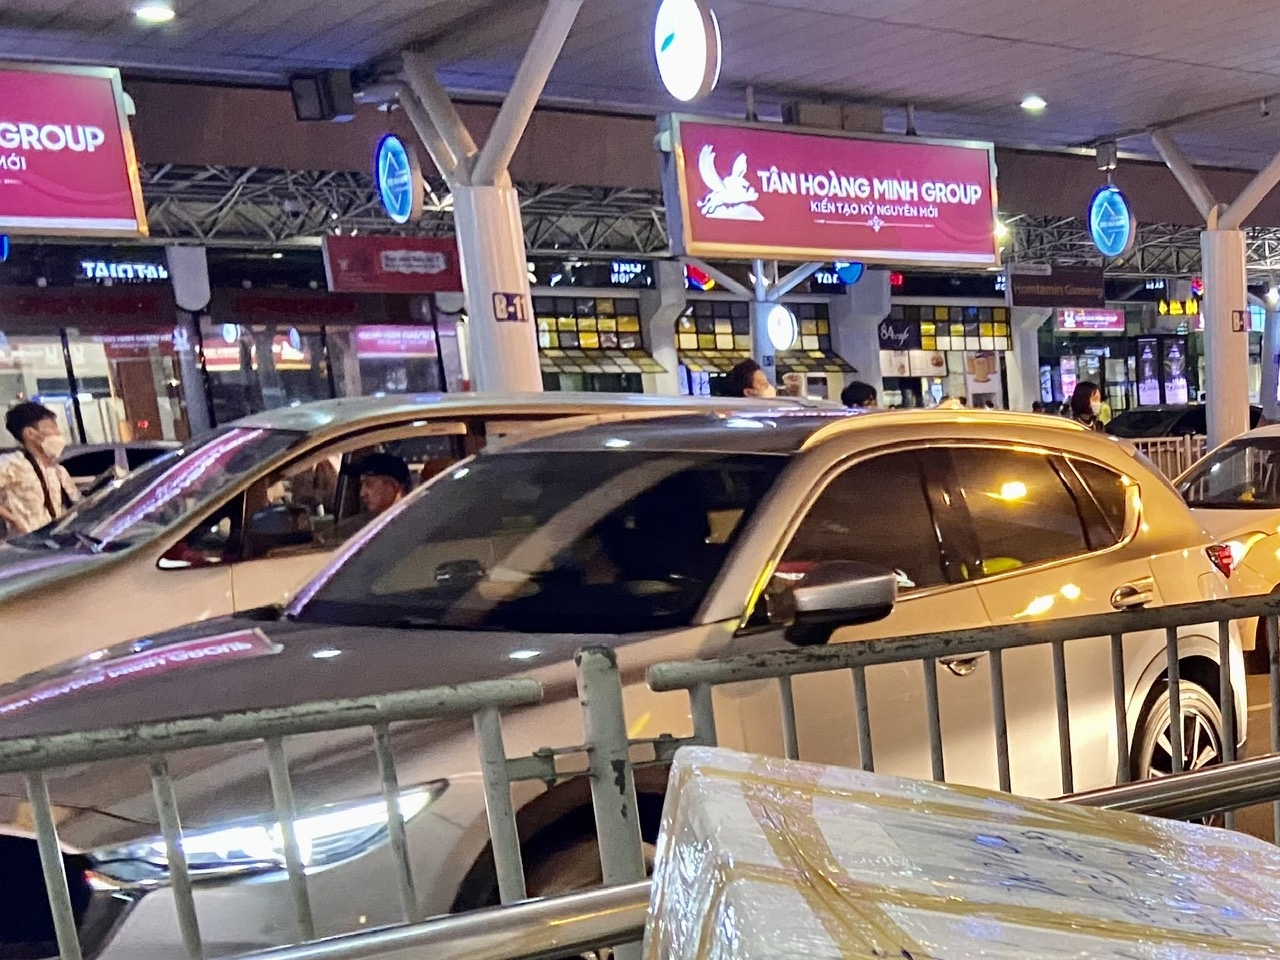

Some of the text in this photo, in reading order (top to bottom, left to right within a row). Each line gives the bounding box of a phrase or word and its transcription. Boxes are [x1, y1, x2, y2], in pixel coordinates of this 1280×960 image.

[0, 121, 105, 152] GROUP
[757, 165, 983, 206] TÂN HOÀNG MINH GROUP
[836, 202, 859, 217] TẠO
[876, 203, 918, 218] NGUYÊN
[919, 204, 939, 218] MỚI
